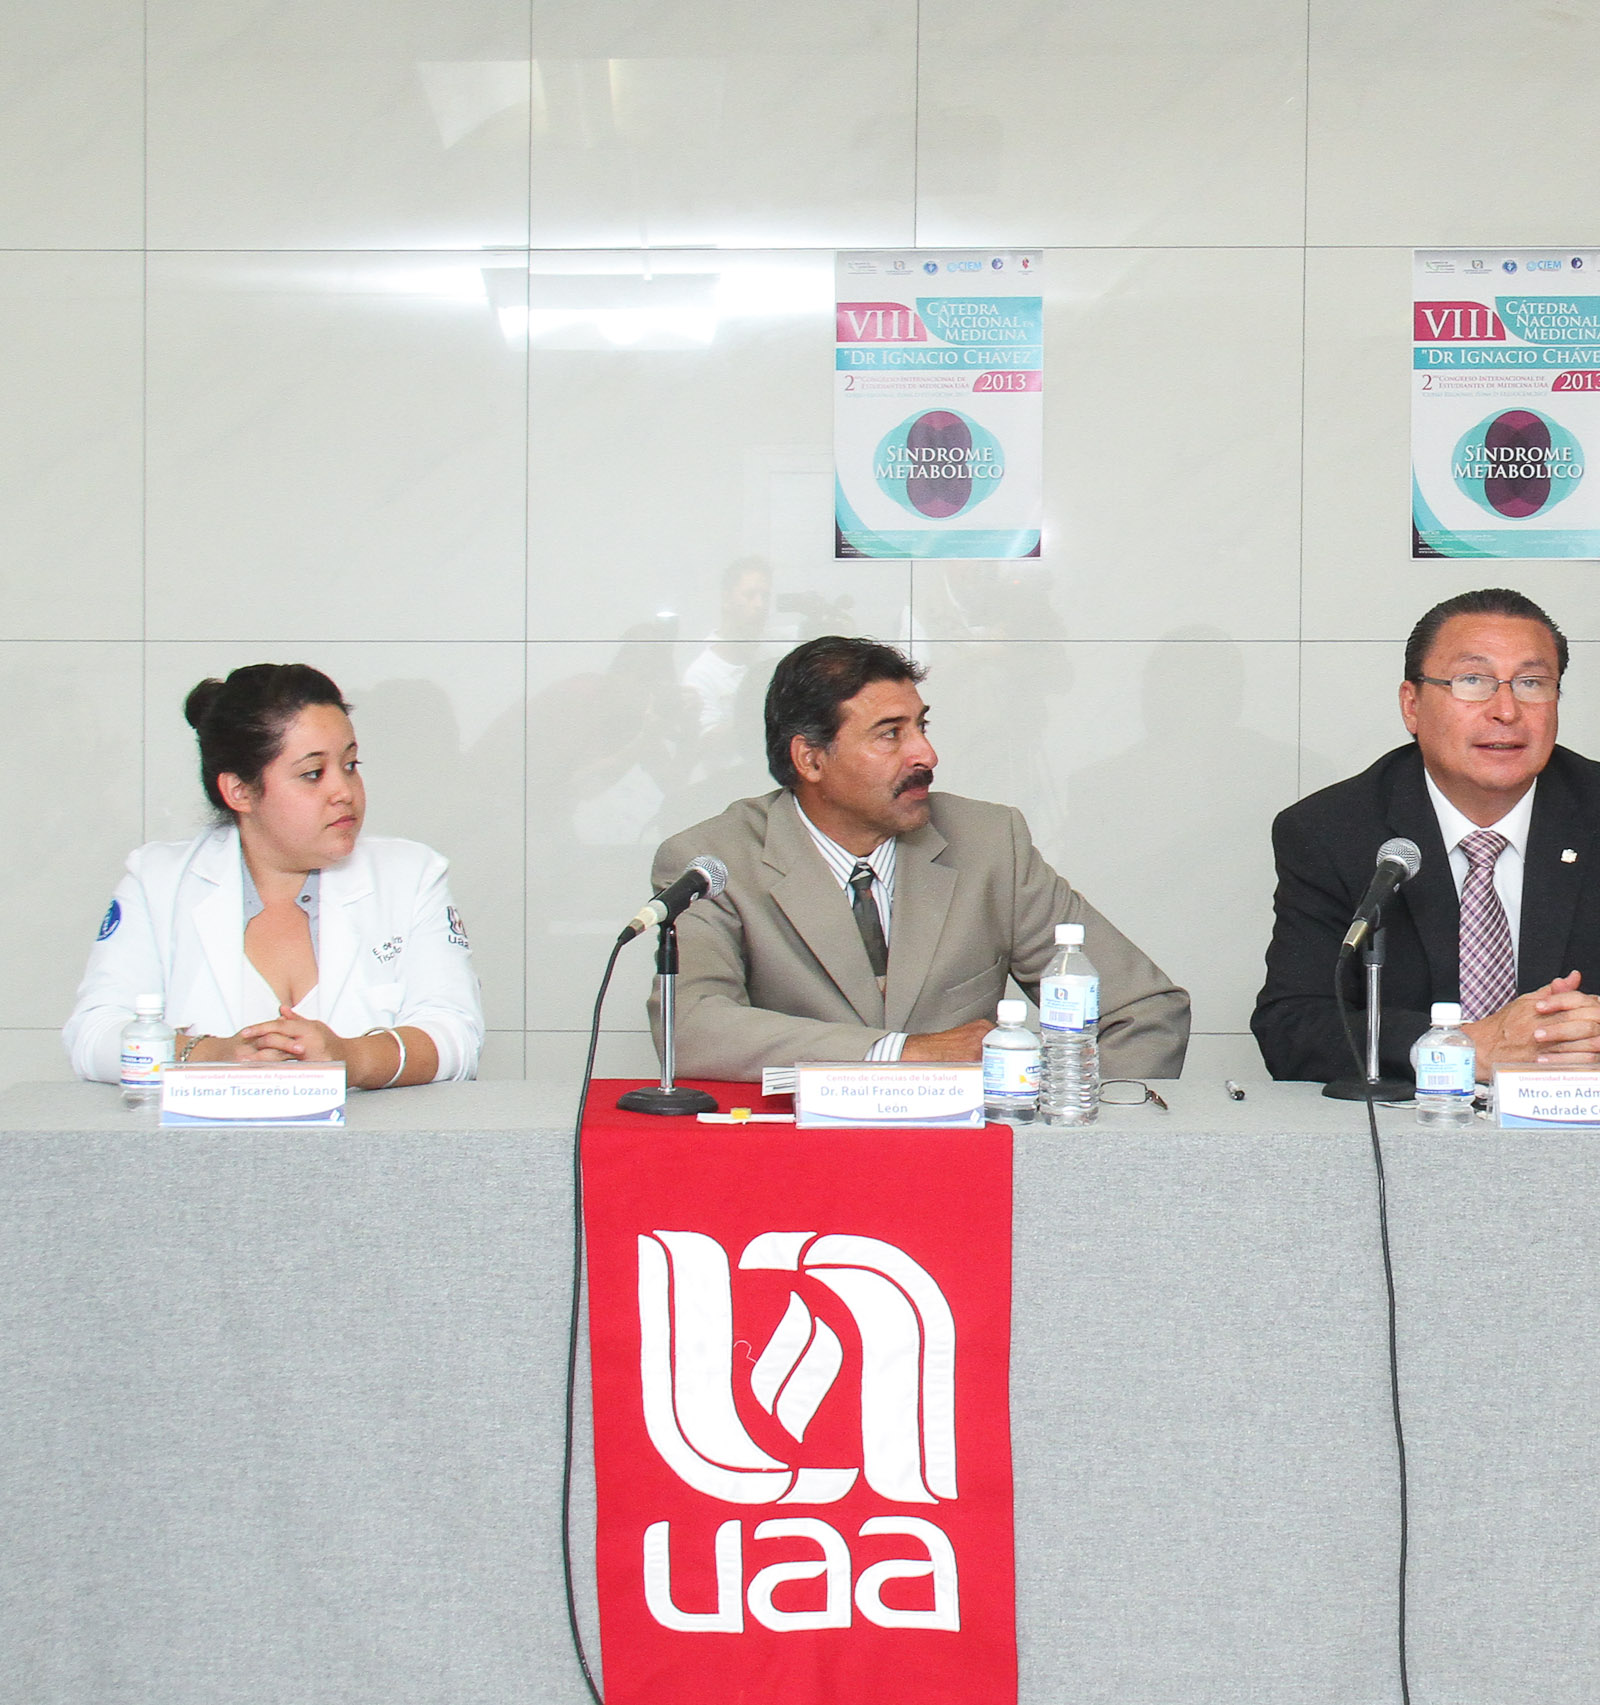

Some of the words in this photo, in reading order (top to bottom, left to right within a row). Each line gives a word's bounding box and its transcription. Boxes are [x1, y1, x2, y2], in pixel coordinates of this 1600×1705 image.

[926, 302, 999, 316] CÁTEDRA
[1506, 300, 1578, 314] CÁTEDRA
[844, 310, 918, 339] VIII
[937, 316, 1023, 328] NACIONAL
[1421, 309, 1496, 338] VIII
[945, 328, 1027, 341] MEDICINA
[882, 350, 958, 364] IGNACIO
[1461, 349, 1537, 364] IGNACIO
[982, 373, 1027, 390] 2013
[887, 444, 993, 462] SÍNDROME
[1464, 444, 1572, 462] SÍNDROME
[875, 461, 1004, 479] METABÓLICO
[1454, 461, 1583, 479] METABÓLICO
[858, 1073, 869, 1081] de
[909, 1073, 920, 1081] de
[922, 1073, 930, 1081] la
[932, 1073, 958, 1081] Salud
[170, 1086, 190, 1097] Iris
[193, 1086, 226, 1097] Ismar
[230, 1085, 289, 1096] Tiscareño
[293, 1086, 338, 1096] Lozano
[820, 1086, 838, 1096] Dr.
[841, 1085, 869, 1096] Raúl
[872, 1086, 914, 1096] Franco
[949, 1085, 964, 1096] de
[1518, 1088, 1552, 1098] Mtro.
[1556, 1090, 1571, 1098] en
[877, 1102, 908, 1113] León
[1532, 1104, 1587, 1116] Andrade
[643, 1516, 960, 1634] uaa
